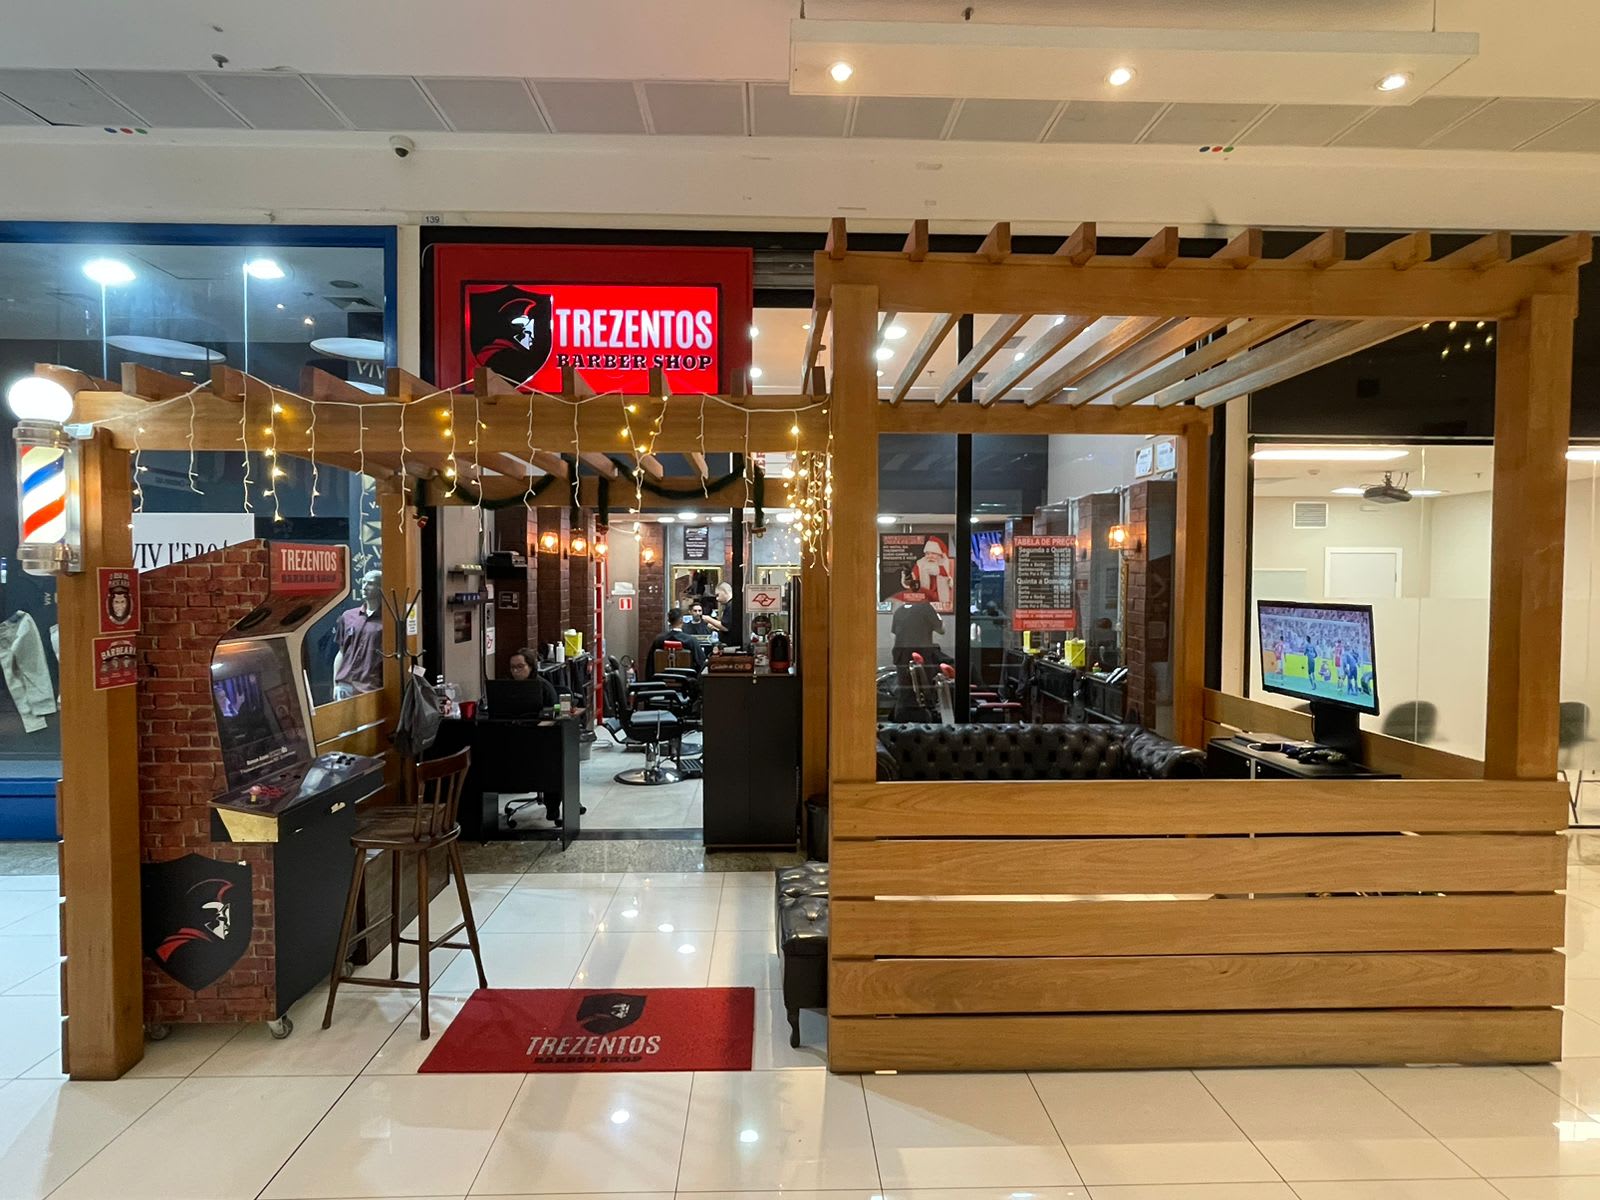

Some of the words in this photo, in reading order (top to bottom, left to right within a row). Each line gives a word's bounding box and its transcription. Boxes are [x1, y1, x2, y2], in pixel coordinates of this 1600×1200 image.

[425, 215, 440, 224] 139
[556, 308, 712, 350] TREZENTOS
[556, 354, 647, 370] BARBER
[653, 354, 713, 370] SHOP
[1014, 538, 1040, 547] TABELA
[1041, 538, 1051, 546] DE
[280, 548, 337, 572] TREZENTOS
[526, 1035, 662, 1056] TREZENTOS
